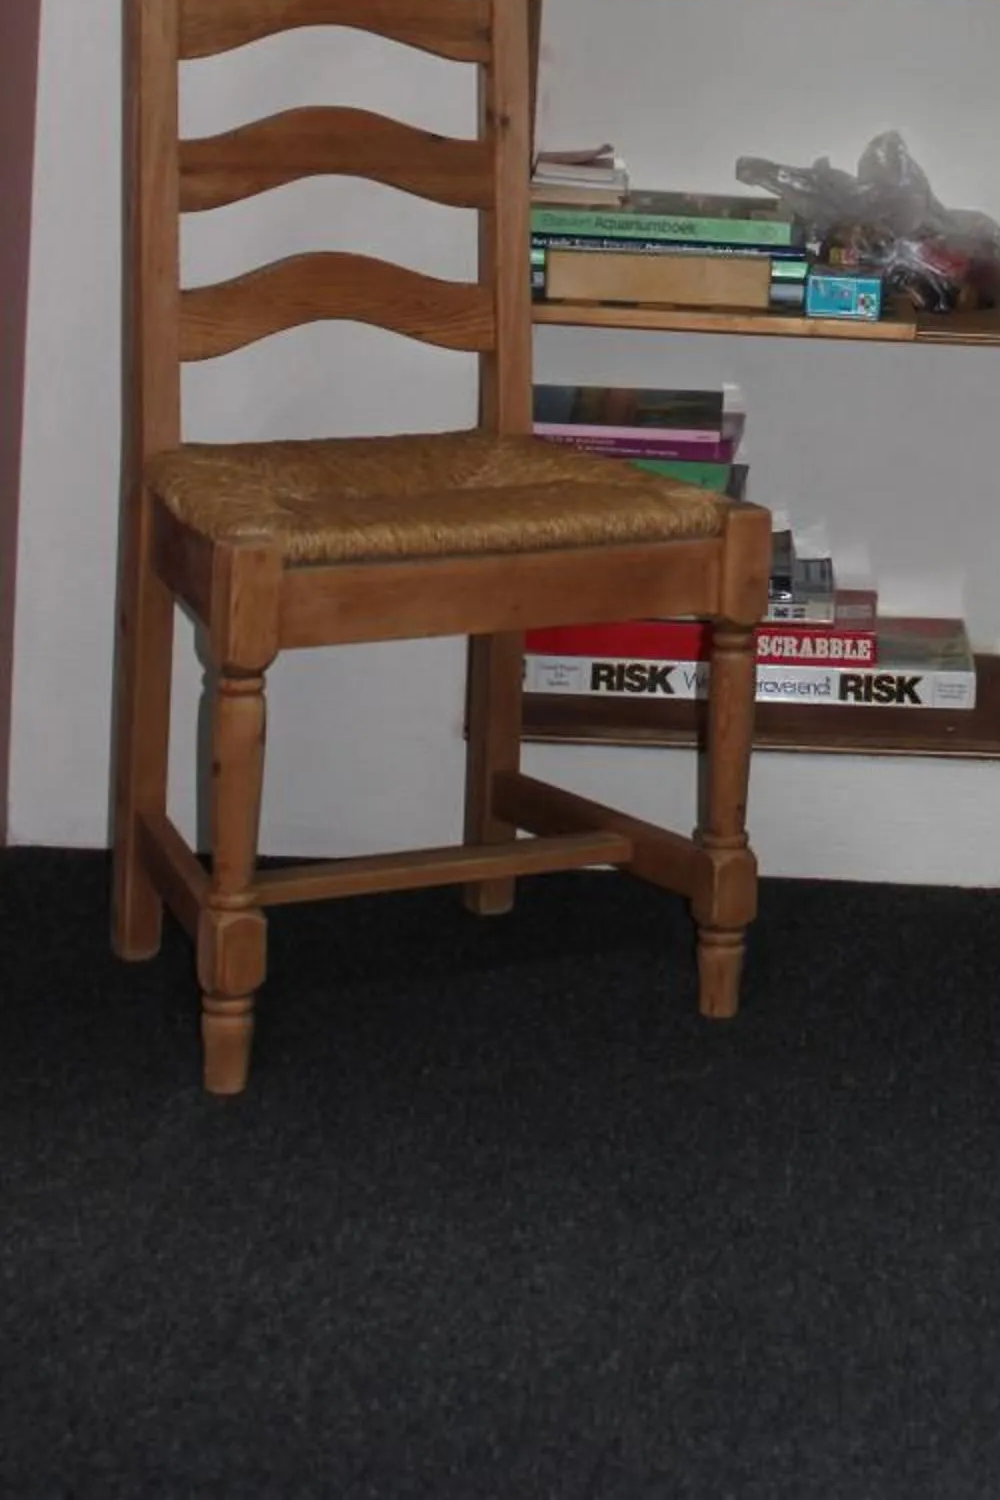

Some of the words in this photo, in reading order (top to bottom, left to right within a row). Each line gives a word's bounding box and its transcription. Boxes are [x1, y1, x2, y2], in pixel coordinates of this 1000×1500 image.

[756, 635, 872, 661] SCRABBLE
[590, 662, 675, 695] RISK
[838, 673, 923, 705] RISK
